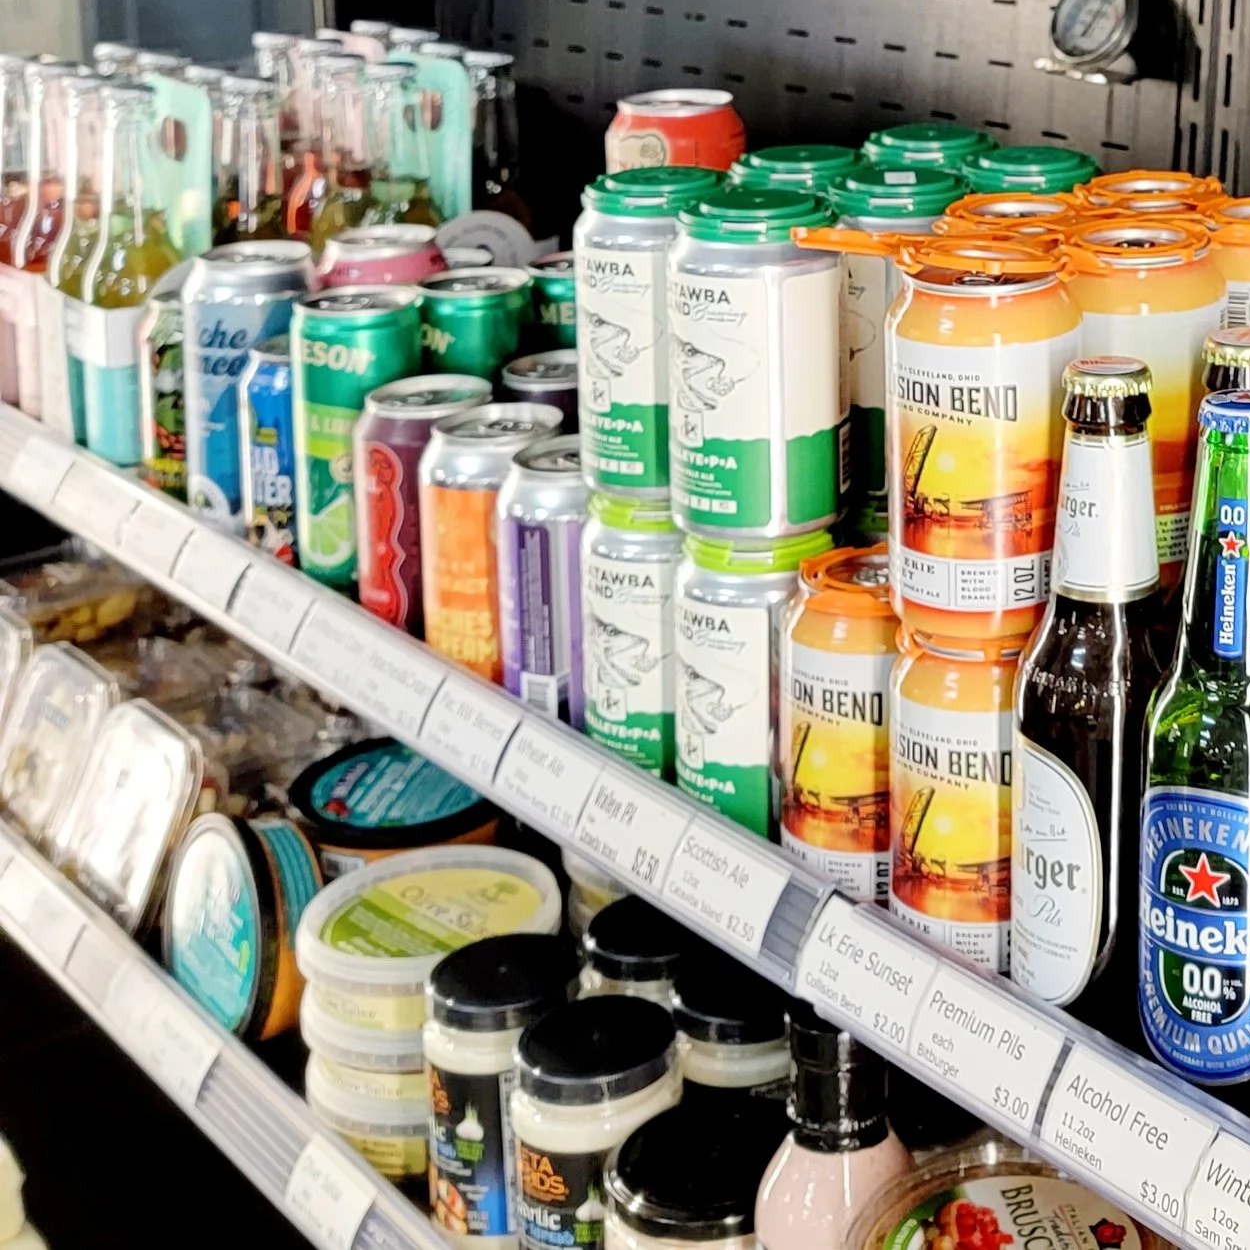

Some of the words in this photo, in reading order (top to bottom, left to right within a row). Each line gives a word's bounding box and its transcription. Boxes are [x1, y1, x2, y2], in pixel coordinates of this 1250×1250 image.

[1219, 505, 1245, 526] 0.0
[903, 557, 936, 575] ERIE
[1013, 558, 1036, 580] OZ.
[1013, 581, 1036, 603] 12
[1219, 562, 1237, 646] Heineken
[822, 689, 883, 727] BEND
[950, 750, 1011, 787] BEND
[681, 835, 729, 877] Scottish
[728, 857, 751, 889] Ale
[817, 921, 834, 947] Lk
[835, 933, 864, 964] Erie
[864, 950, 914, 996] Sunset
[818, 960, 840, 982] 12oz
[1182, 962, 1222, 1000] 0.0
[1222, 985, 1237, 1001] %
[804, 972, 840, 1004] Collision
[840, 993, 863, 1019] Bend
[872, 1011, 905, 1044] $2.00
[1143, 968, 1201, 1052] PREMIUM
[1182, 996, 1222, 1014] ALCOHOL
[1190, 1010, 1213, 1025] FREE
[928, 989, 996, 1044] Premium
[997, 1028, 1027, 1062] Pils
[931, 1032, 955, 1053] each
[916, 1041, 960, 1081] Bitburger
[991, 1085, 1030, 1121] $3.00
[1066, 1073, 1129, 1123] Alcohol
[1128, 1110, 1170, 1151] Free
[1054, 1129, 1104, 1171] Heineken
[1139, 1178, 1180, 1220] $3.00
[1211, 1206, 1240, 1234] 12oz
